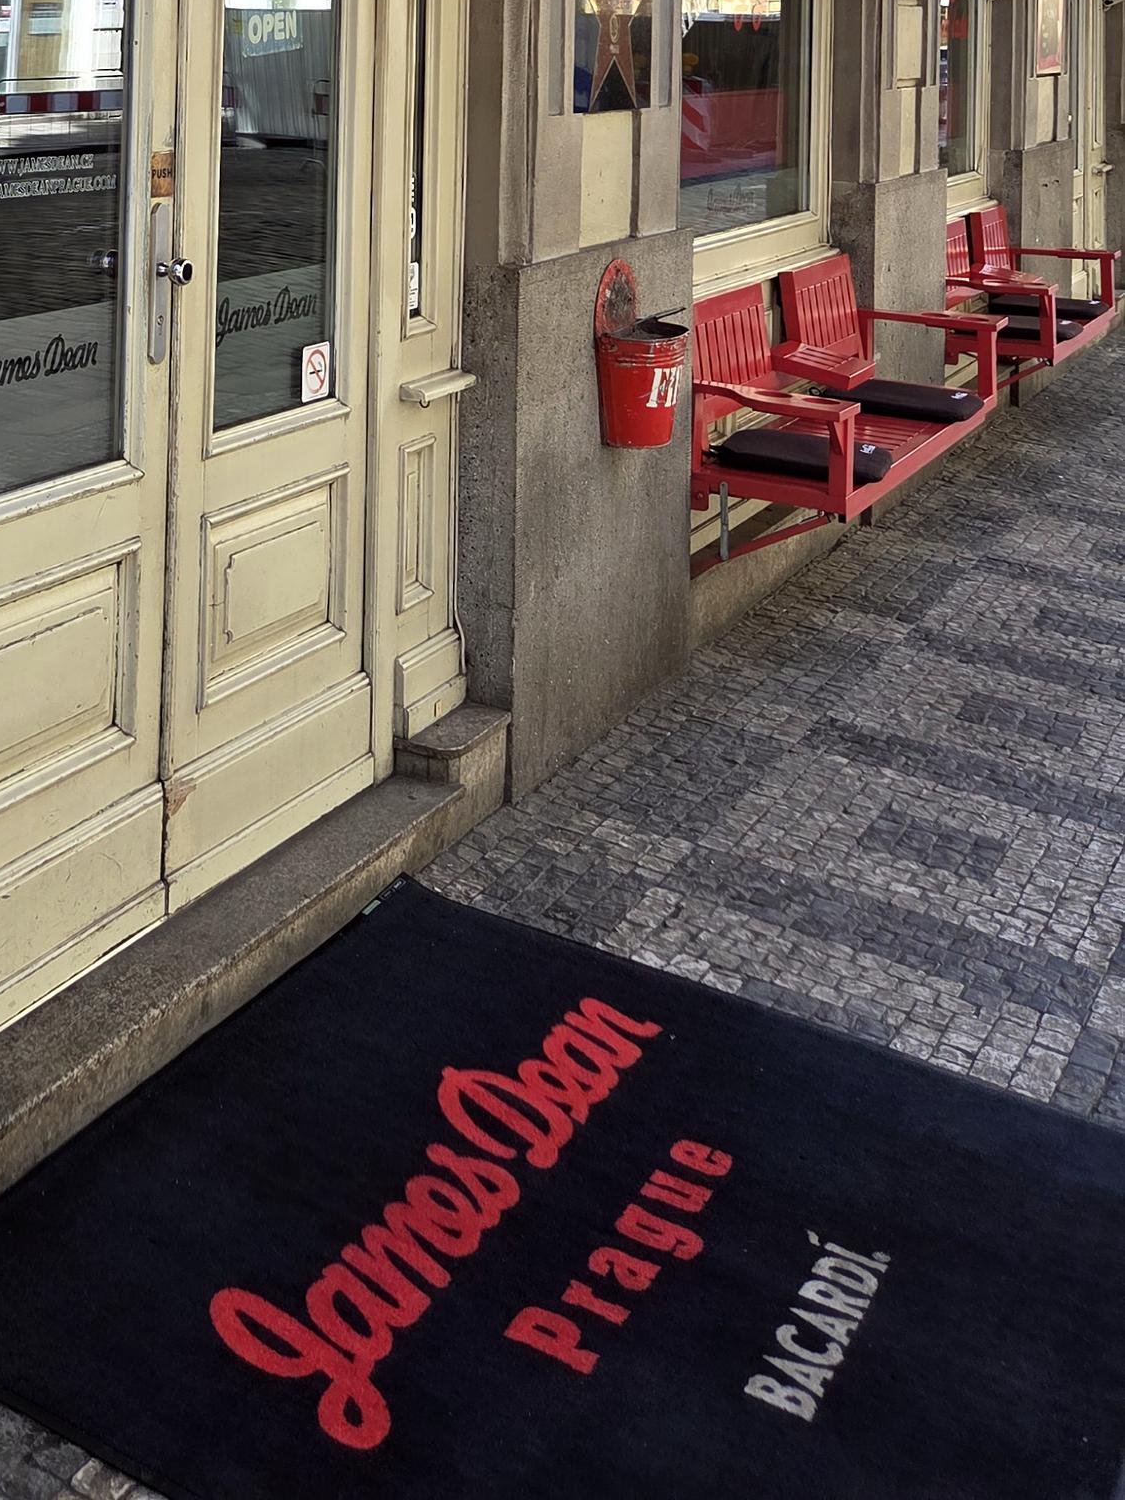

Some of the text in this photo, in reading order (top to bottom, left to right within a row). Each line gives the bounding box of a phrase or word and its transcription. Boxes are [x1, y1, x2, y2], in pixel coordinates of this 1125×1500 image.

[248, 11, 296, 44] OPEN
[151, 169, 173, 180] PUSH
[216, 286, 317, 348] James Dean
[43, 334, 99, 376] Dean
[209, 996, 663, 1451] James Dean
[504, 1139, 733, 1375] Prague
